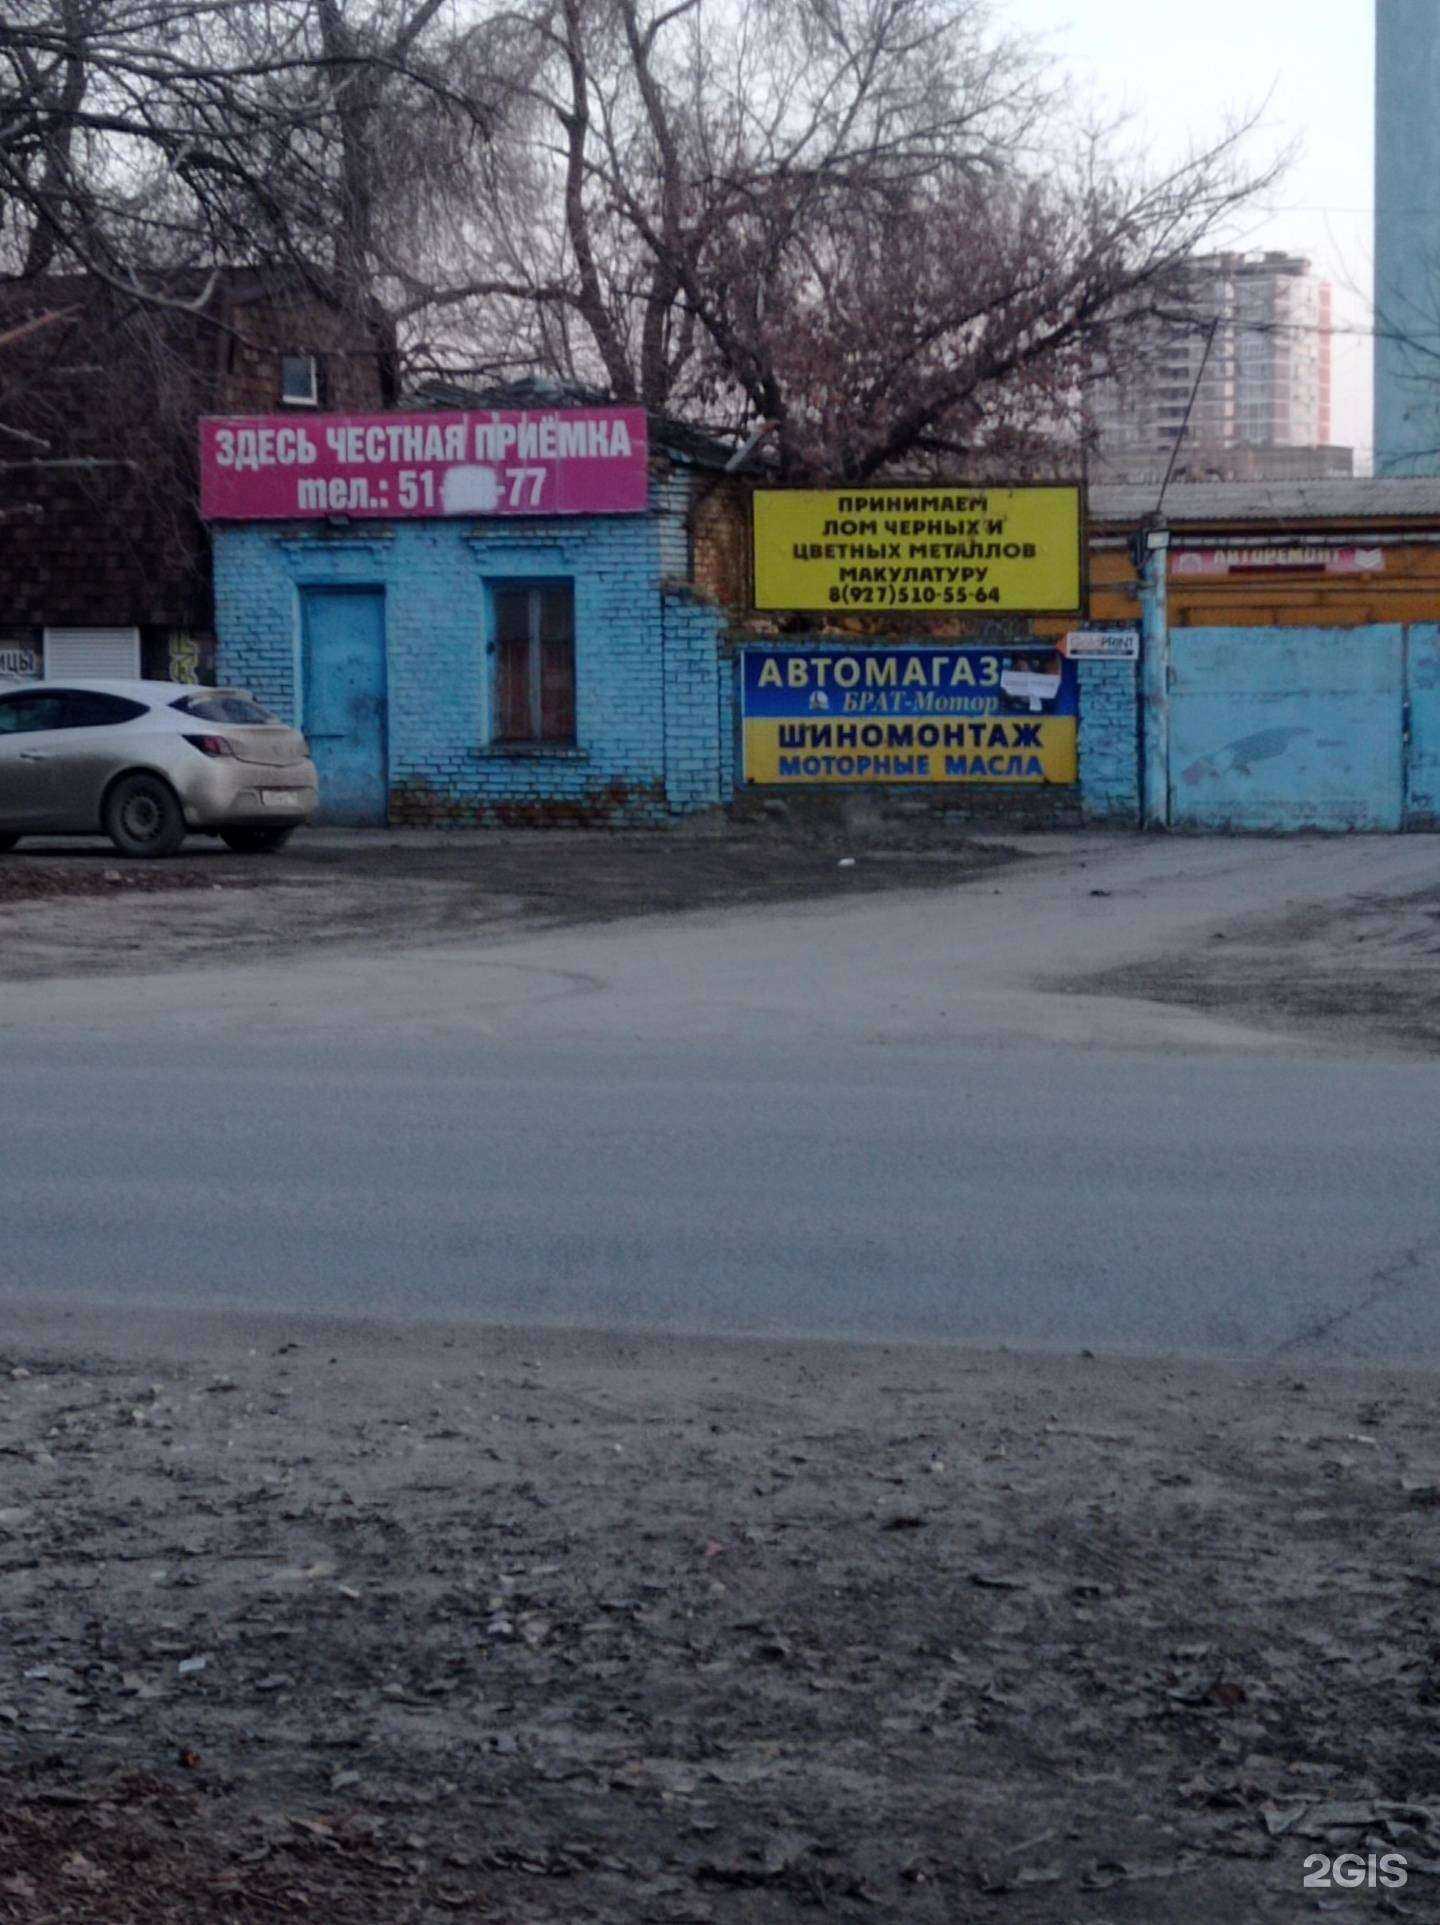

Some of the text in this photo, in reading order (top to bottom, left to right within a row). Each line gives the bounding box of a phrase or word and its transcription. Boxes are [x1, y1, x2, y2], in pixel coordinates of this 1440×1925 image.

[214, 417, 632, 471] ЗДЕСЬ ЧЕСТНАЯ ПРИЁМКА
[838, 496, 988, 513] ПРИНИМАЕМ
[822, 519, 1004, 537] ЛОМ ЧЕРНЫХ И
[792, 541, 1037, 561] ЦВЕТНЫХ МЕТАЛЛОВ
[838, 566, 988, 583] МАКУЛАТУРУ
[828, 584, 1000, 605] 8(927)510-55-64
[757, 656, 1000, 688] АВТОМАГАЗ
[777, 722, 1044, 749] ШИНОМОНТАЖ
[778, 753, 1045, 777] МОТОРНЫЕ МАСЛА
